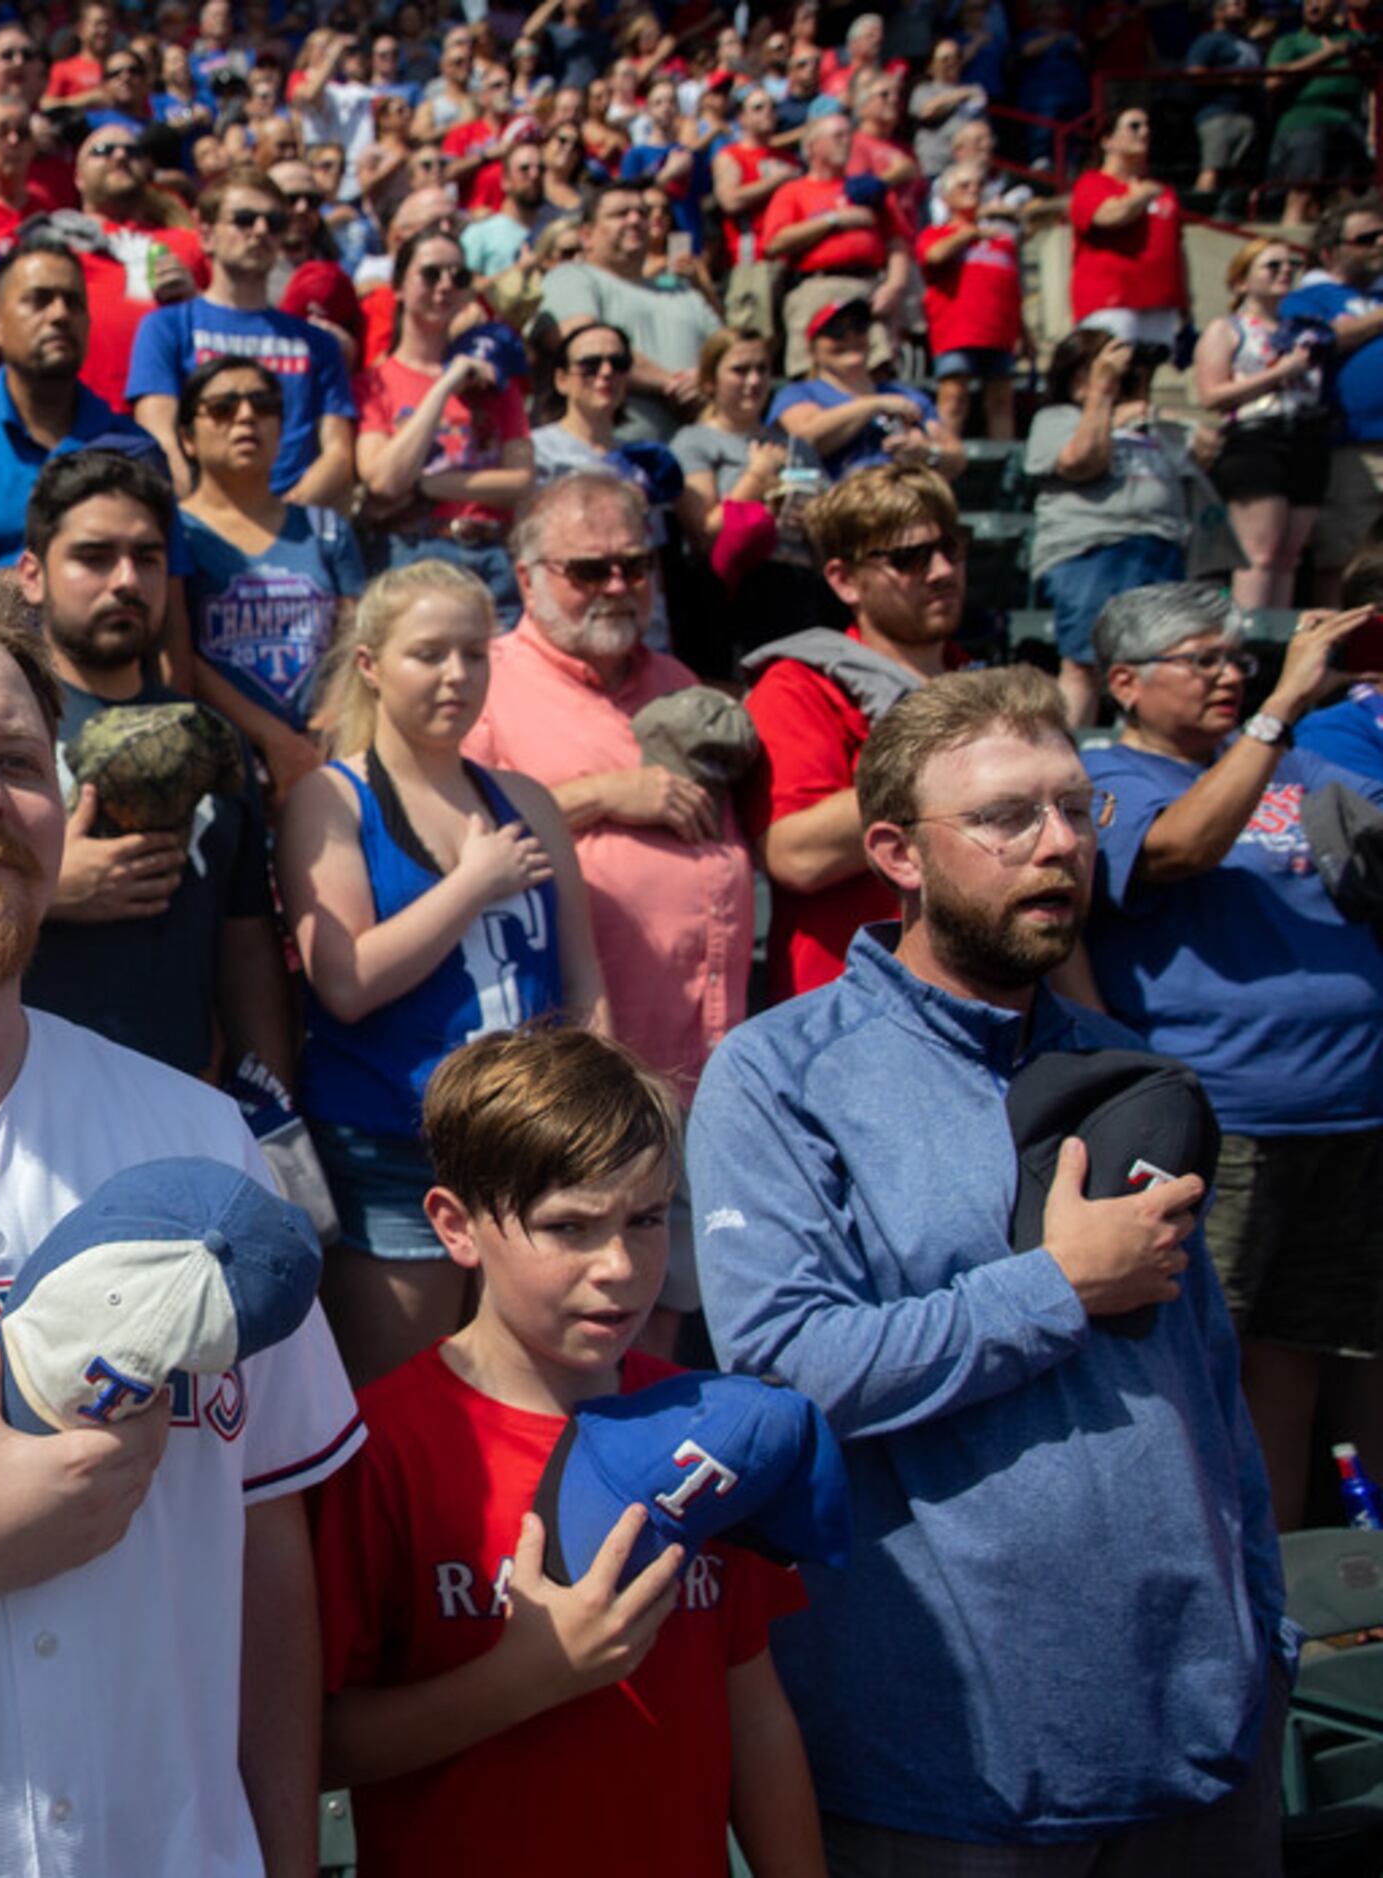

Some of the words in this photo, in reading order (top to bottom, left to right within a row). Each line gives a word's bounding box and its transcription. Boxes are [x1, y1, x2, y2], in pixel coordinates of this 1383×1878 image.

[258, 644, 297, 682] T
[77, 1355, 155, 1422] T
[655, 1439, 739, 1521] T
